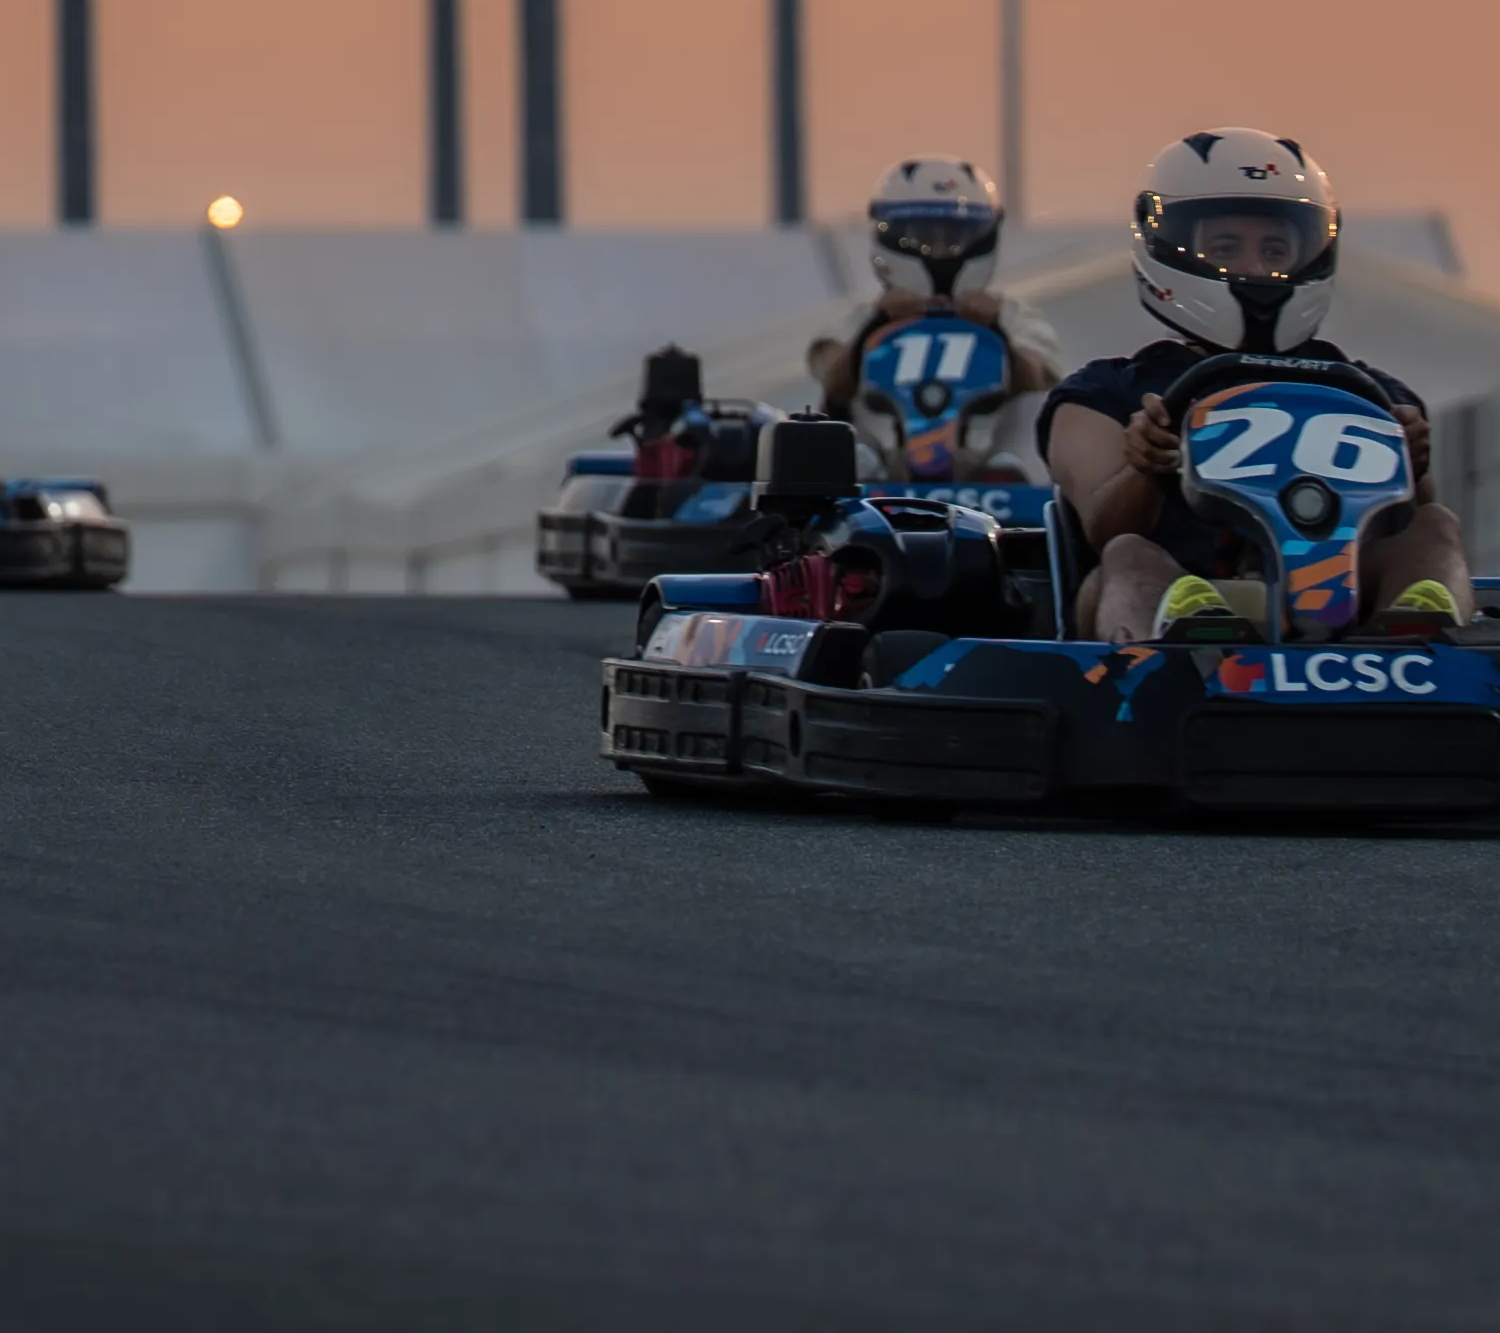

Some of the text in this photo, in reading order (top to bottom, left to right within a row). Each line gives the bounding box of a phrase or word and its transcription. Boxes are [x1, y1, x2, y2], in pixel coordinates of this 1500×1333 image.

[893, 333, 979, 385] 11
[1196, 406, 1404, 483] 26
[1270, 652, 1437, 694] LCSC
